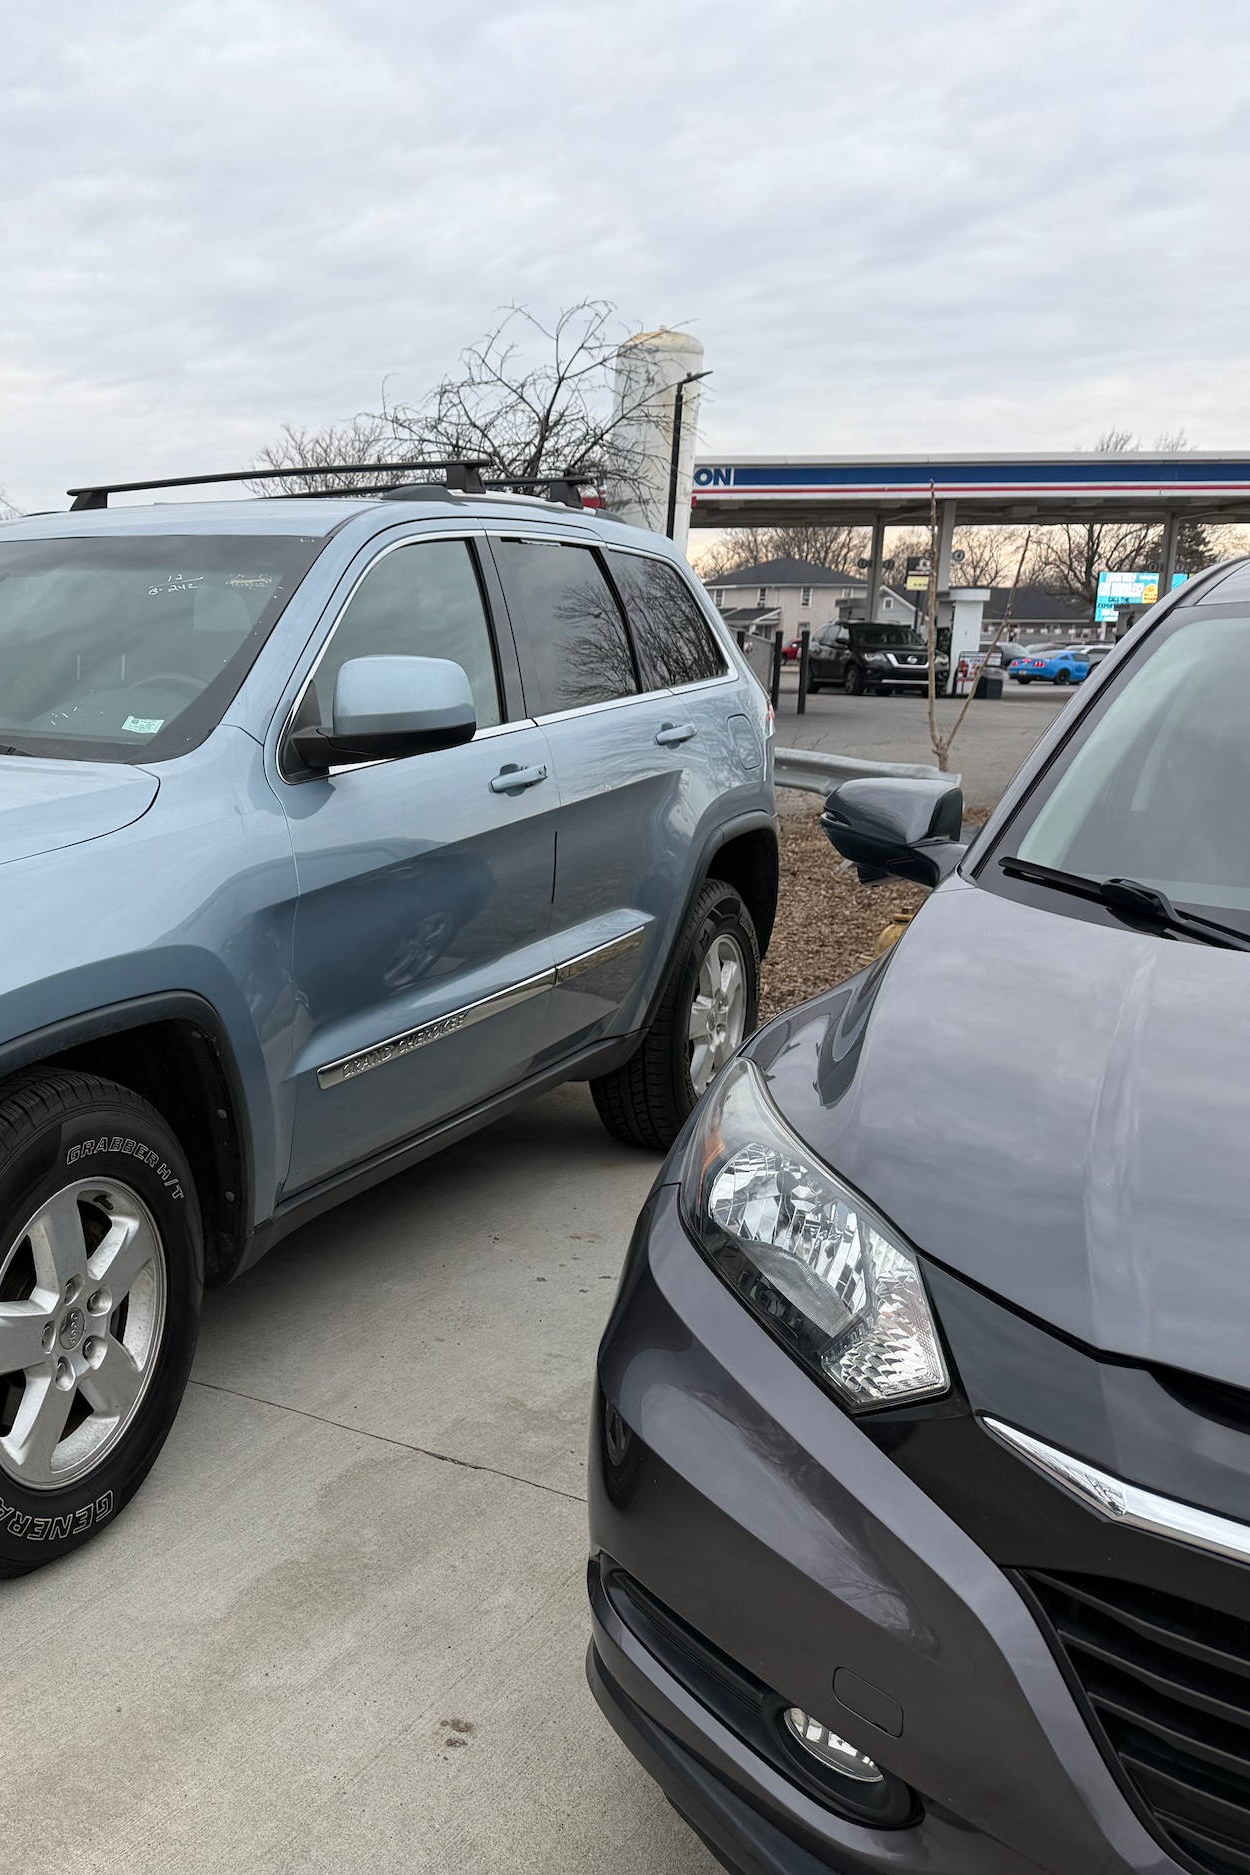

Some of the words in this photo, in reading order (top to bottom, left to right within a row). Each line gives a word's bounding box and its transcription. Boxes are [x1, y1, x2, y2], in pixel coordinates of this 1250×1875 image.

[694, 468, 732, 486] ON
[342, 1045, 394, 1078] GRAND
[398, 1014, 466, 1054] CHEROKEE
[67, 1137, 159, 1168] GRABBER
[157, 1163, 184, 1199] H/T
